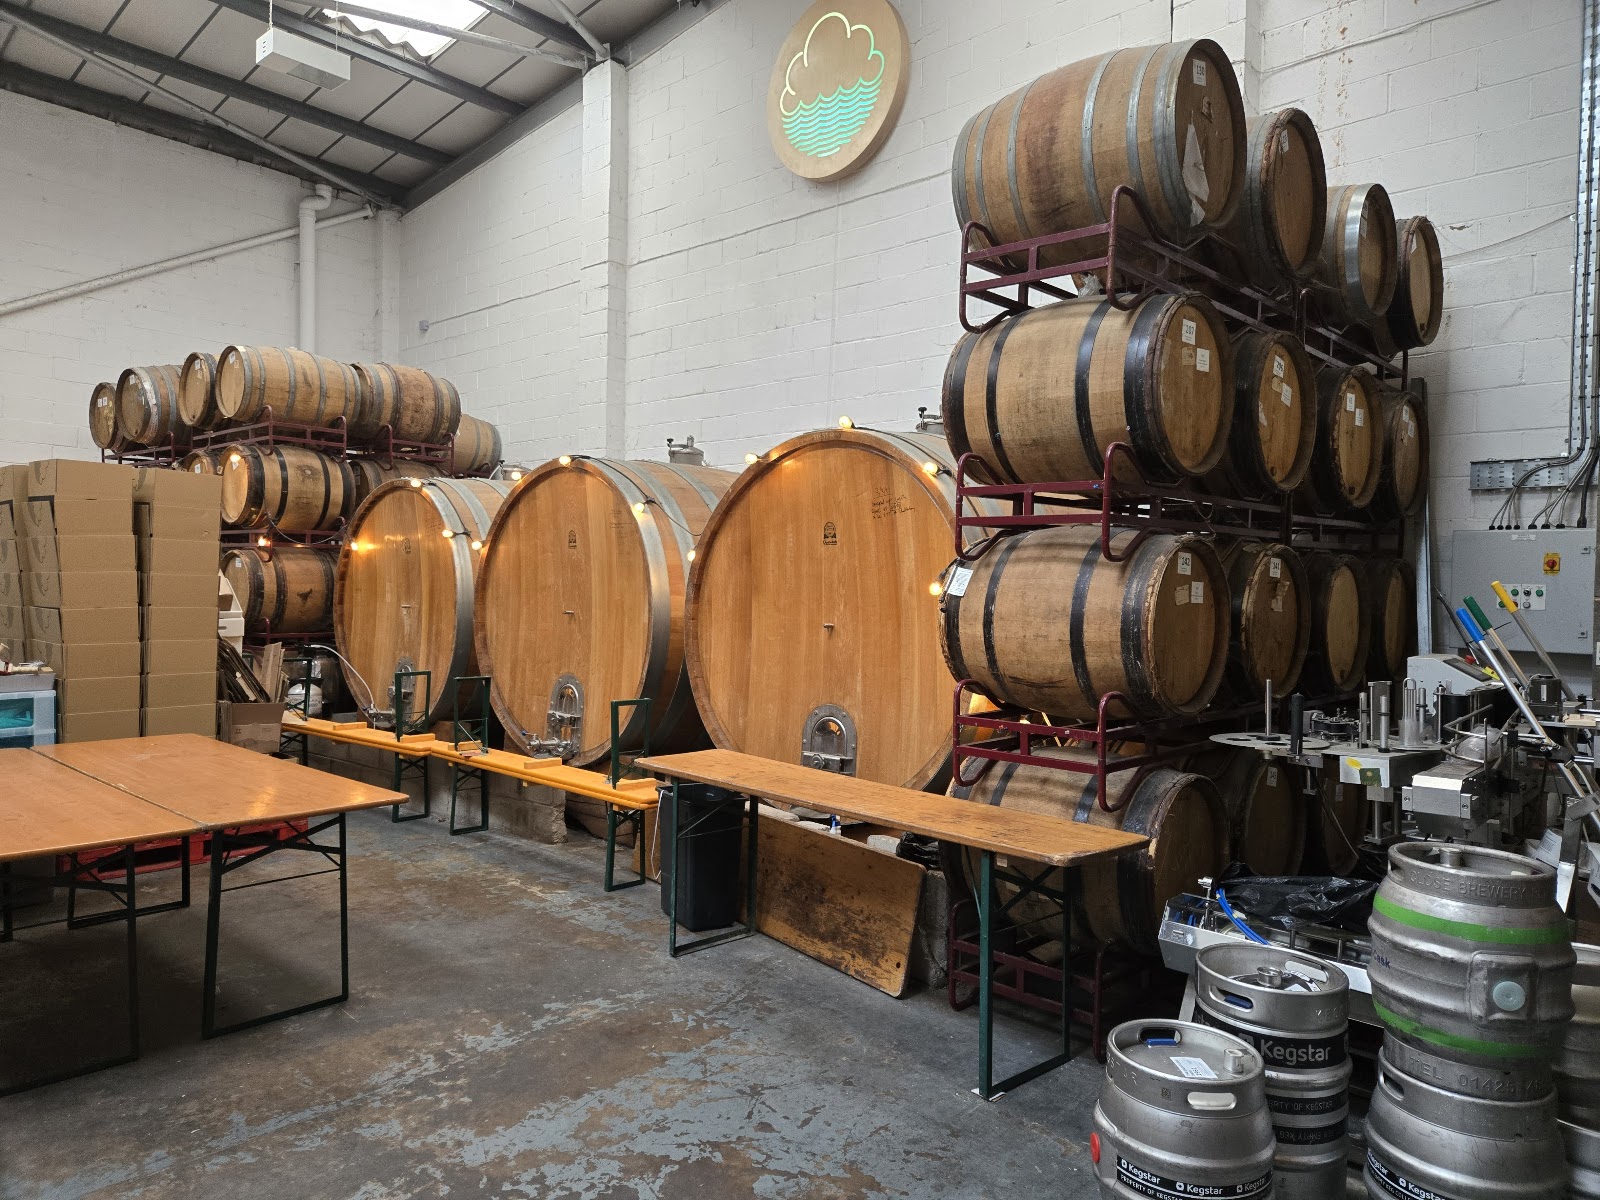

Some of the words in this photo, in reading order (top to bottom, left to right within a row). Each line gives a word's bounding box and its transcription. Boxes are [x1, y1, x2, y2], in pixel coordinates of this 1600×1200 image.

[1458, 880, 1526, 901] BREWERY
[1260, 1038, 1331, 1065] Kegstar
[1293, 1101, 1303, 1111] OF
[1305, 1100, 1333, 1111] KEGSTAR
[1279, 1130, 1296, 1142] KEG
[1120, 1174, 1146, 1192] PROPERTY
[1147, 1188, 1156, 1196] OF
[1128, 1164, 1161, 1184] Kegstar
[1186, 1184, 1224, 1195] Kegstar
